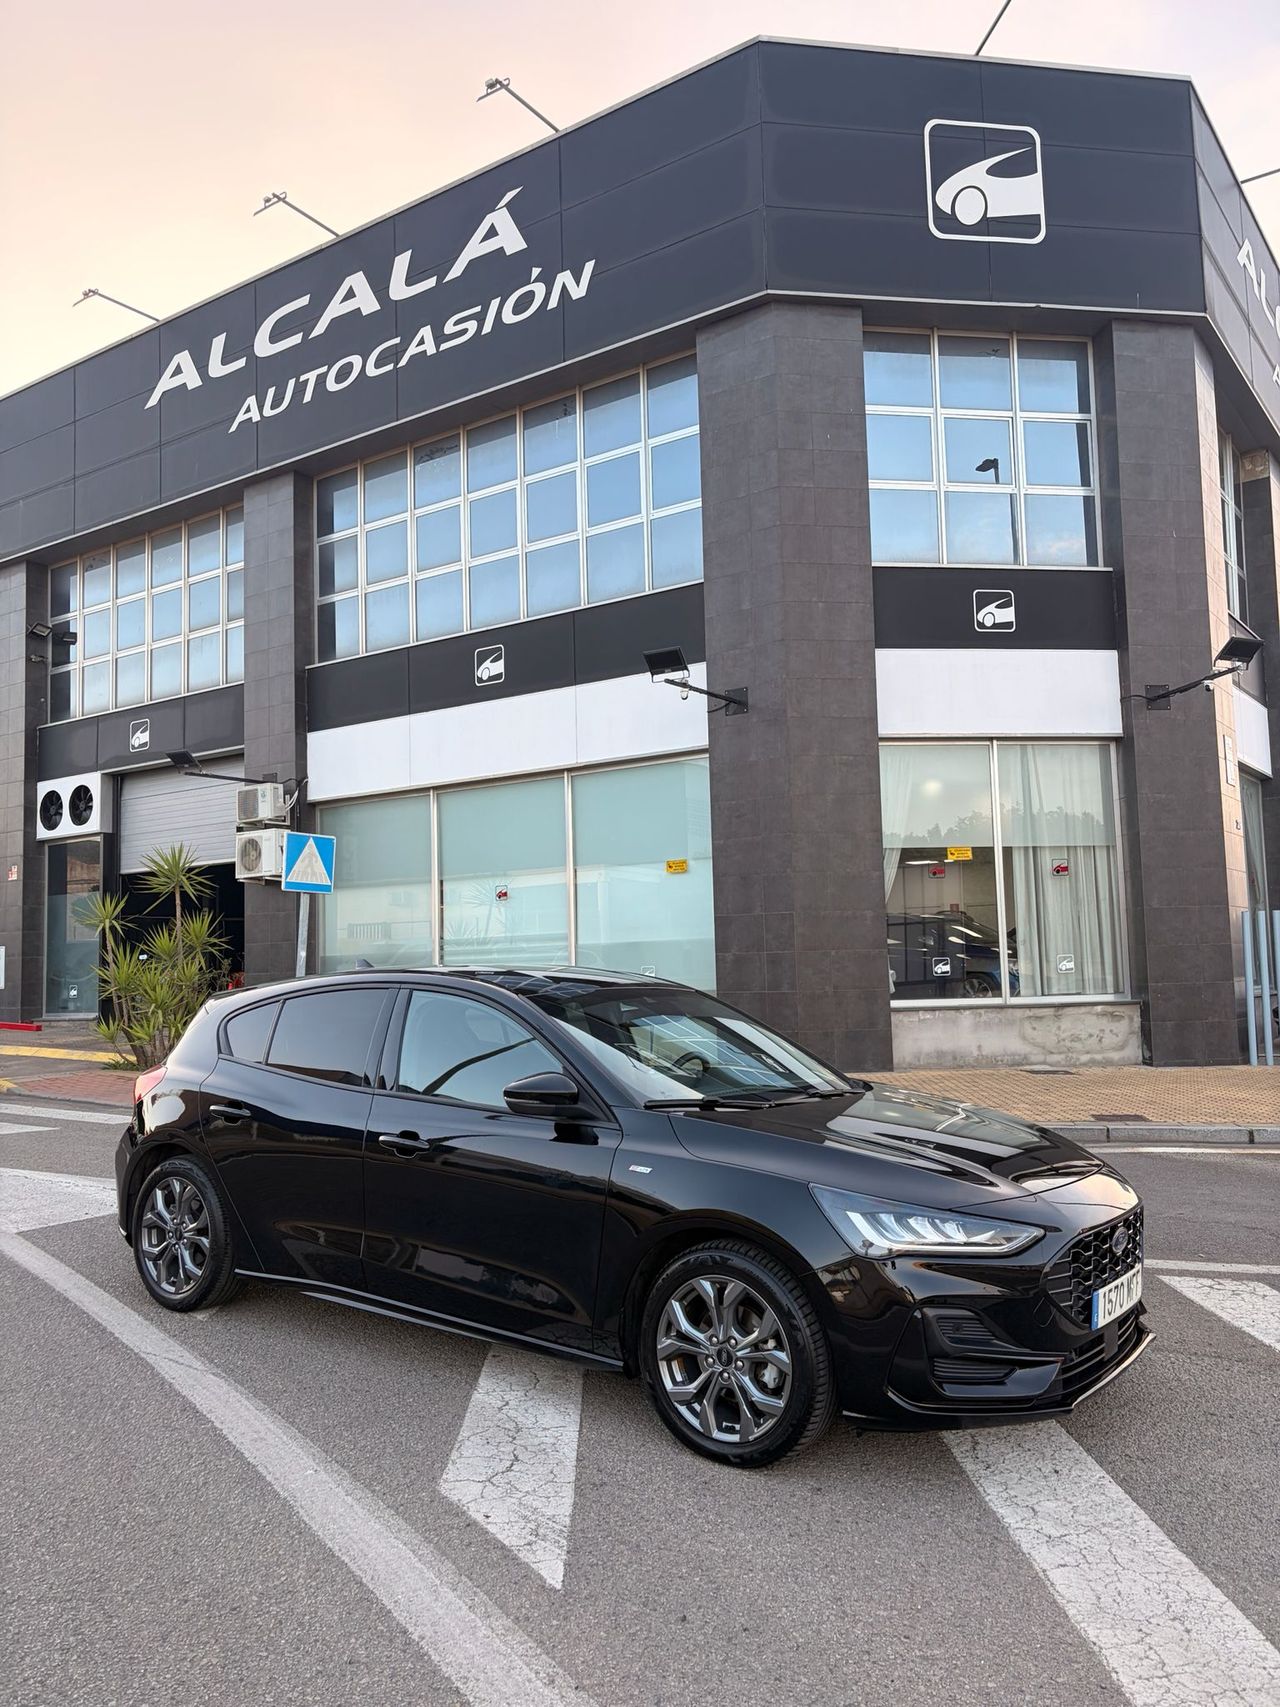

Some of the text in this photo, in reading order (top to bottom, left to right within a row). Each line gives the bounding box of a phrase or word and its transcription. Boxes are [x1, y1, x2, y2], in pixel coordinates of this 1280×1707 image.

[144, 185, 528, 410] ALCALÁ
[228, 259, 596, 434] AUTOCASIÓN
[1103, 1281, 1125, 1320] 1570
